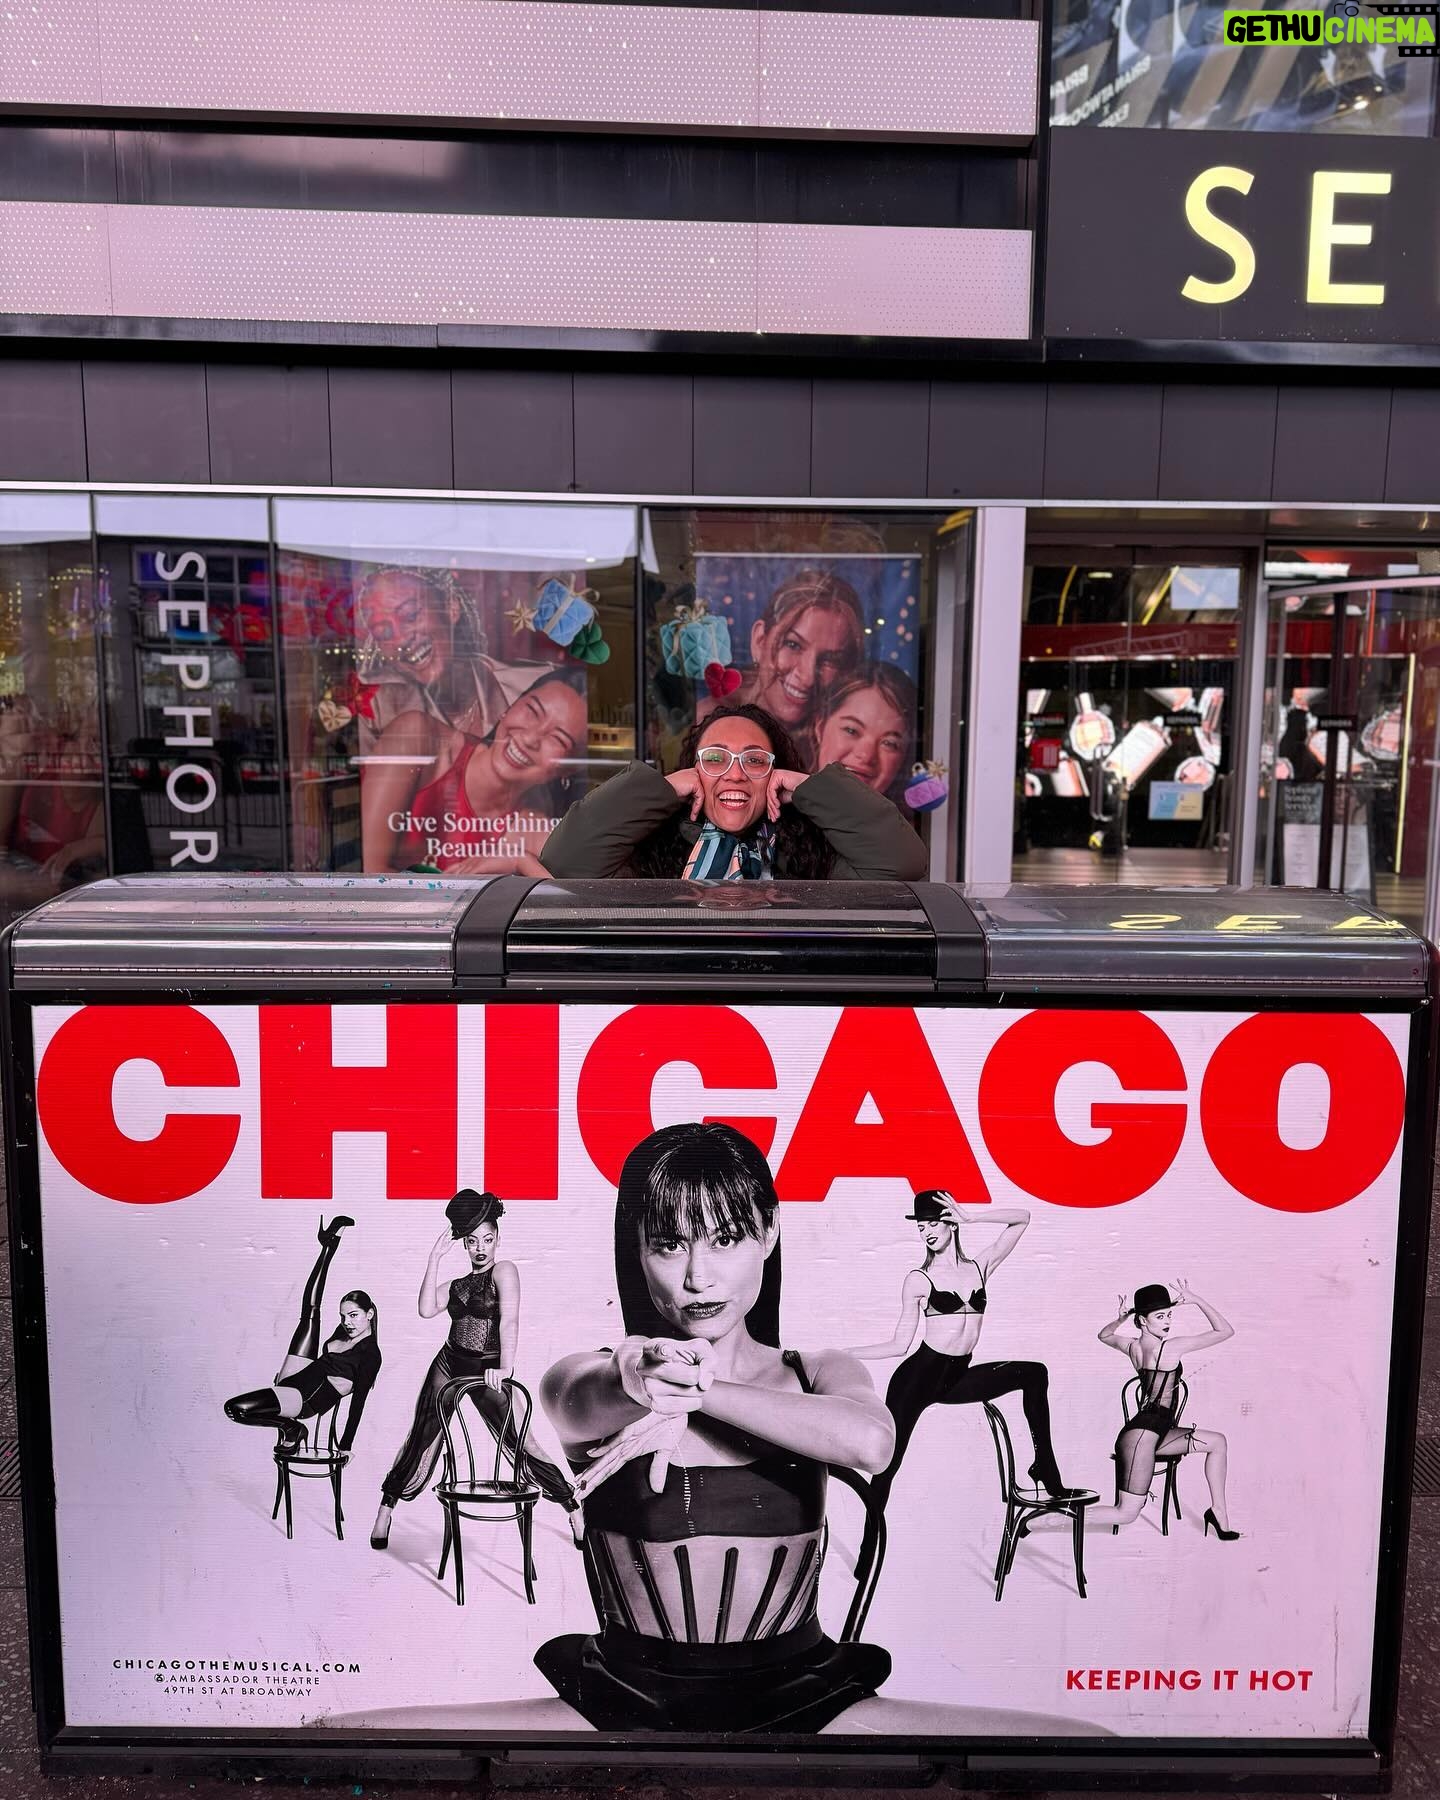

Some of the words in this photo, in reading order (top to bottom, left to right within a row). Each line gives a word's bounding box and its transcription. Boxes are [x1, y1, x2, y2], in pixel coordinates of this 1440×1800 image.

[387, 811, 437, 833] Give
[426, 837, 526, 858] Beautiful
[37, 1004, 1405, 1213] CHICAGO
[112, 1659, 361, 1674] CHICAGOTHEMUSICAL.COM
[169, 1674, 259, 1685] AMBASSADOR
[265, 1675, 321, 1686] THEATRE
[1066, 1669, 1202, 1691] KEEPING
[1213, 1670, 1239, 1691] IT
[1250, 1670, 1313, 1692] HOT
[163, 1686, 195, 1695] 49TH
[201, 1686, 214, 1695] ST
[221, 1687, 235, 1695] AT
[241, 1687, 312, 1697] BROADWAY
